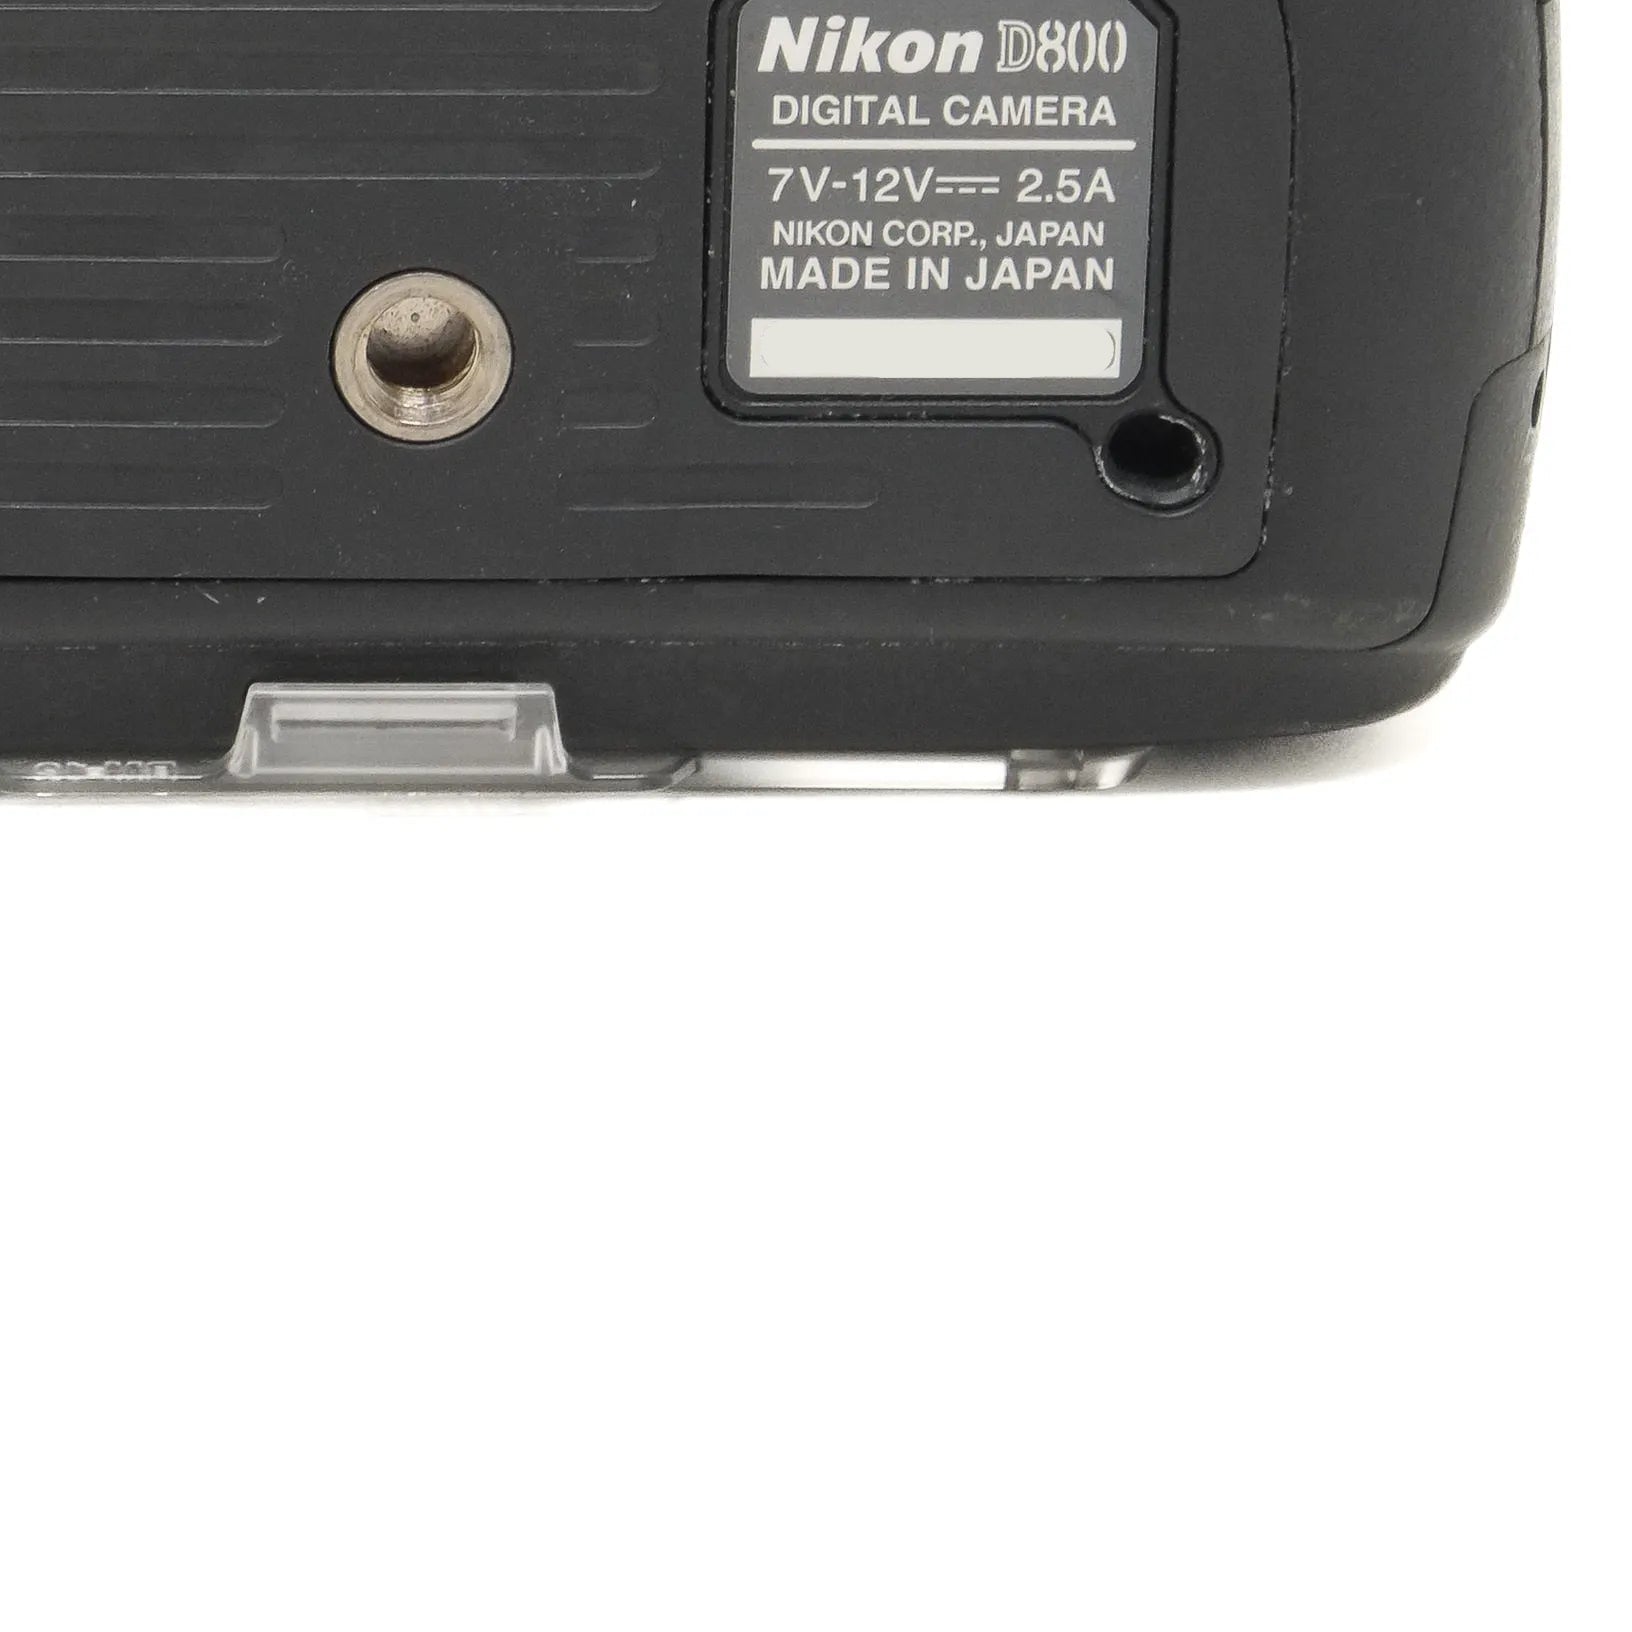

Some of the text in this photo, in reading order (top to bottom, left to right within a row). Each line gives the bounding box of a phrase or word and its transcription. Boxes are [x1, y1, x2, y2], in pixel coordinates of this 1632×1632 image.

[757, 14, 1129, 74] Nikon D800
[772, 94, 1117, 127] DIGITAL CAMERA
[1016, 166, 1116, 204] 2.5A
[772, 218, 1105, 252] NIKON CORP., JAPAN
[760, 256, 1115, 291] MADE IN JAPAN
